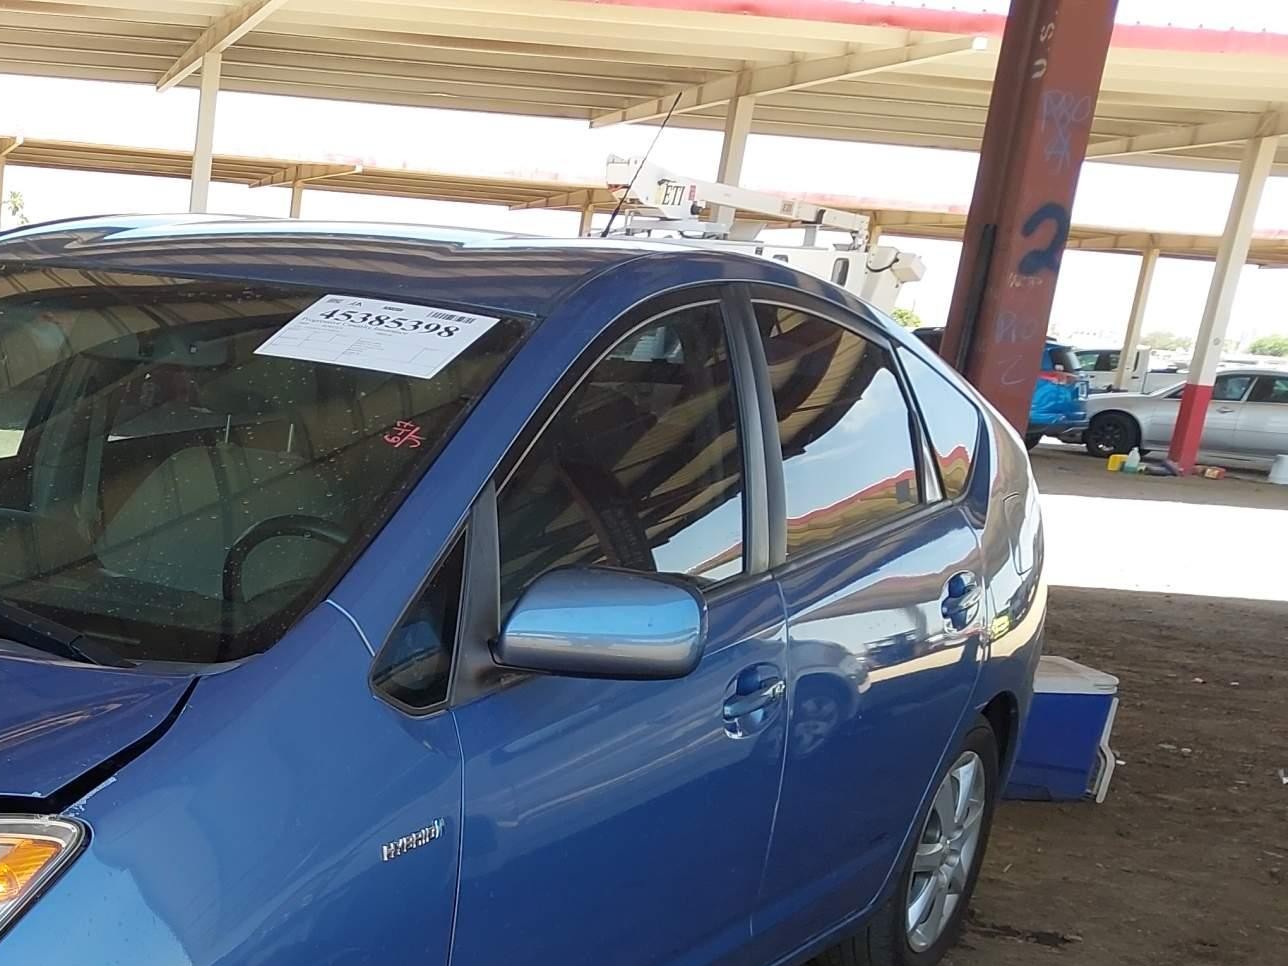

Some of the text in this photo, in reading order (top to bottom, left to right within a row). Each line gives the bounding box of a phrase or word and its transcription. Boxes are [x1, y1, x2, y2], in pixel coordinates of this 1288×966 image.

[662, 184, 686, 206] ETI
[1019, 202, 1070, 276] 2
[319, 308, 460, 338] 45385398
